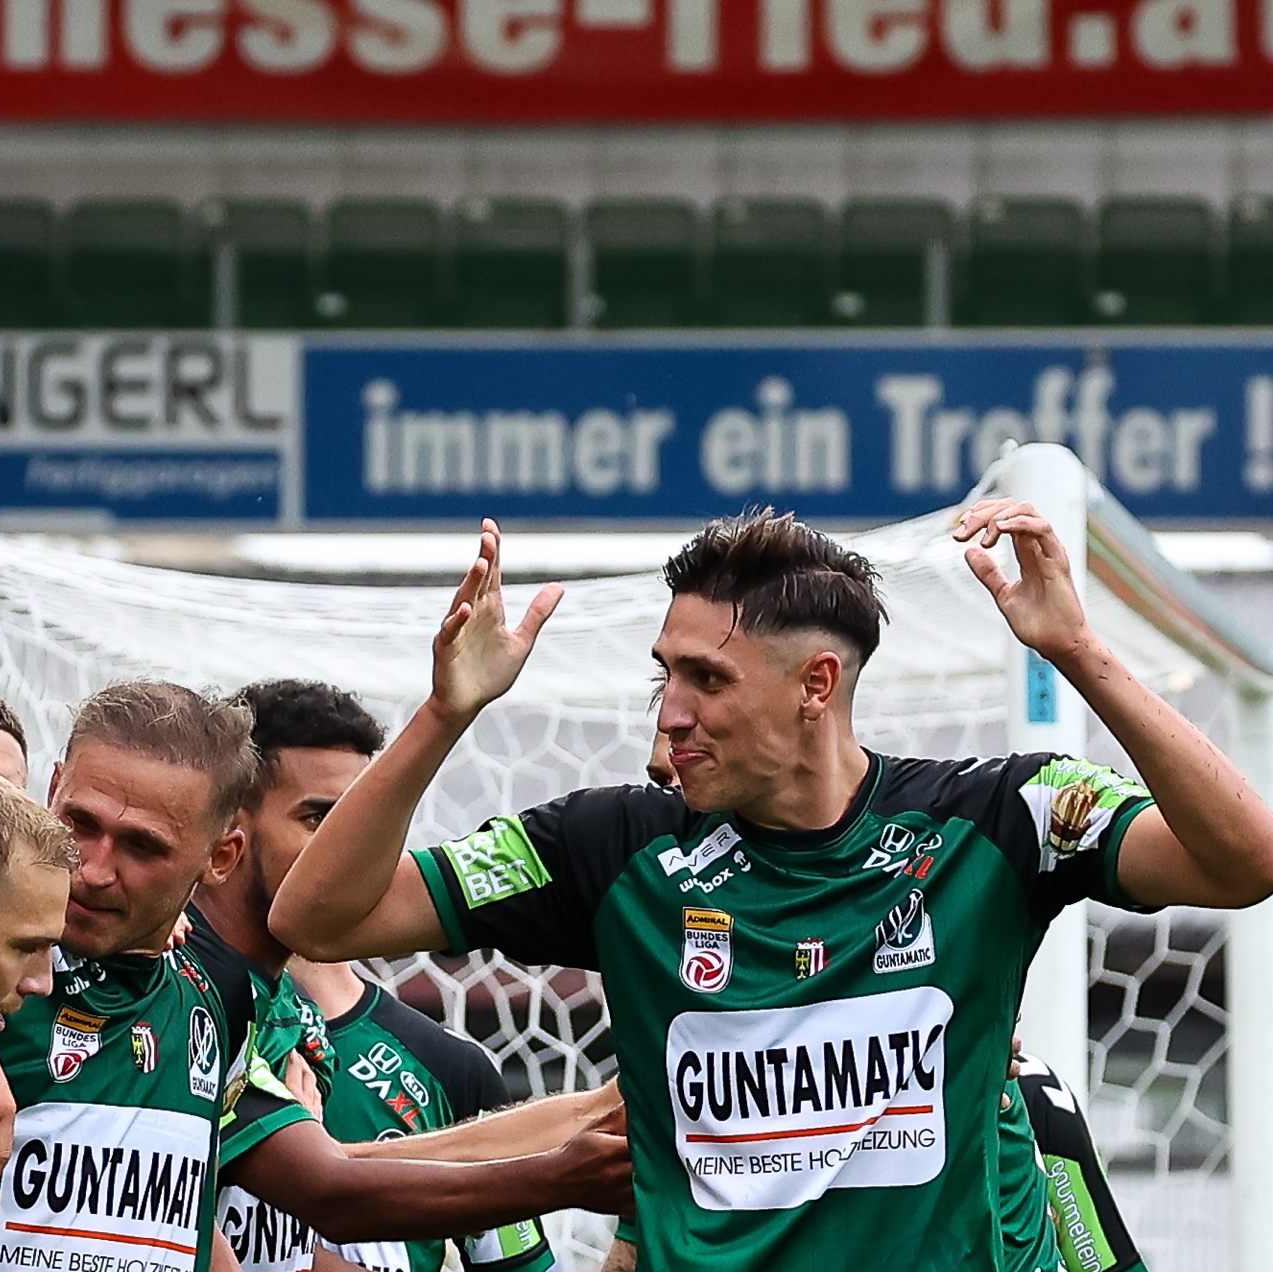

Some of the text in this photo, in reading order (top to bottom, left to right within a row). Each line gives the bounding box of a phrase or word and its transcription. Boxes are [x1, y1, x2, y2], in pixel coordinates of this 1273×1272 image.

[363, 376, 674, 495] immer
[700, 375, 852, 495] ein
[876, 364, 1217, 495] Treffer
[465, 859, 529, 901] BET
[686, 914, 729, 926] ADMIRAL
[686, 930, 729, 942] BUNDES
[695, 940, 721, 950] LIGA
[875, 947, 932, 969] GUNTAMATIC
[55, 1026, 97, 1044] BUNDES
[61, 1036, 87, 1048] LIGA
[675, 1023, 944, 1122] GUNTAMATIC
[347, 1053, 422, 1131] DAXL
[402, 1074, 426, 1104] KIA
[685, 1155, 744, 1176] MEINE
[749, 1152, 804, 1175] BESTE
[0, 1244, 65, 1271] MEINE
